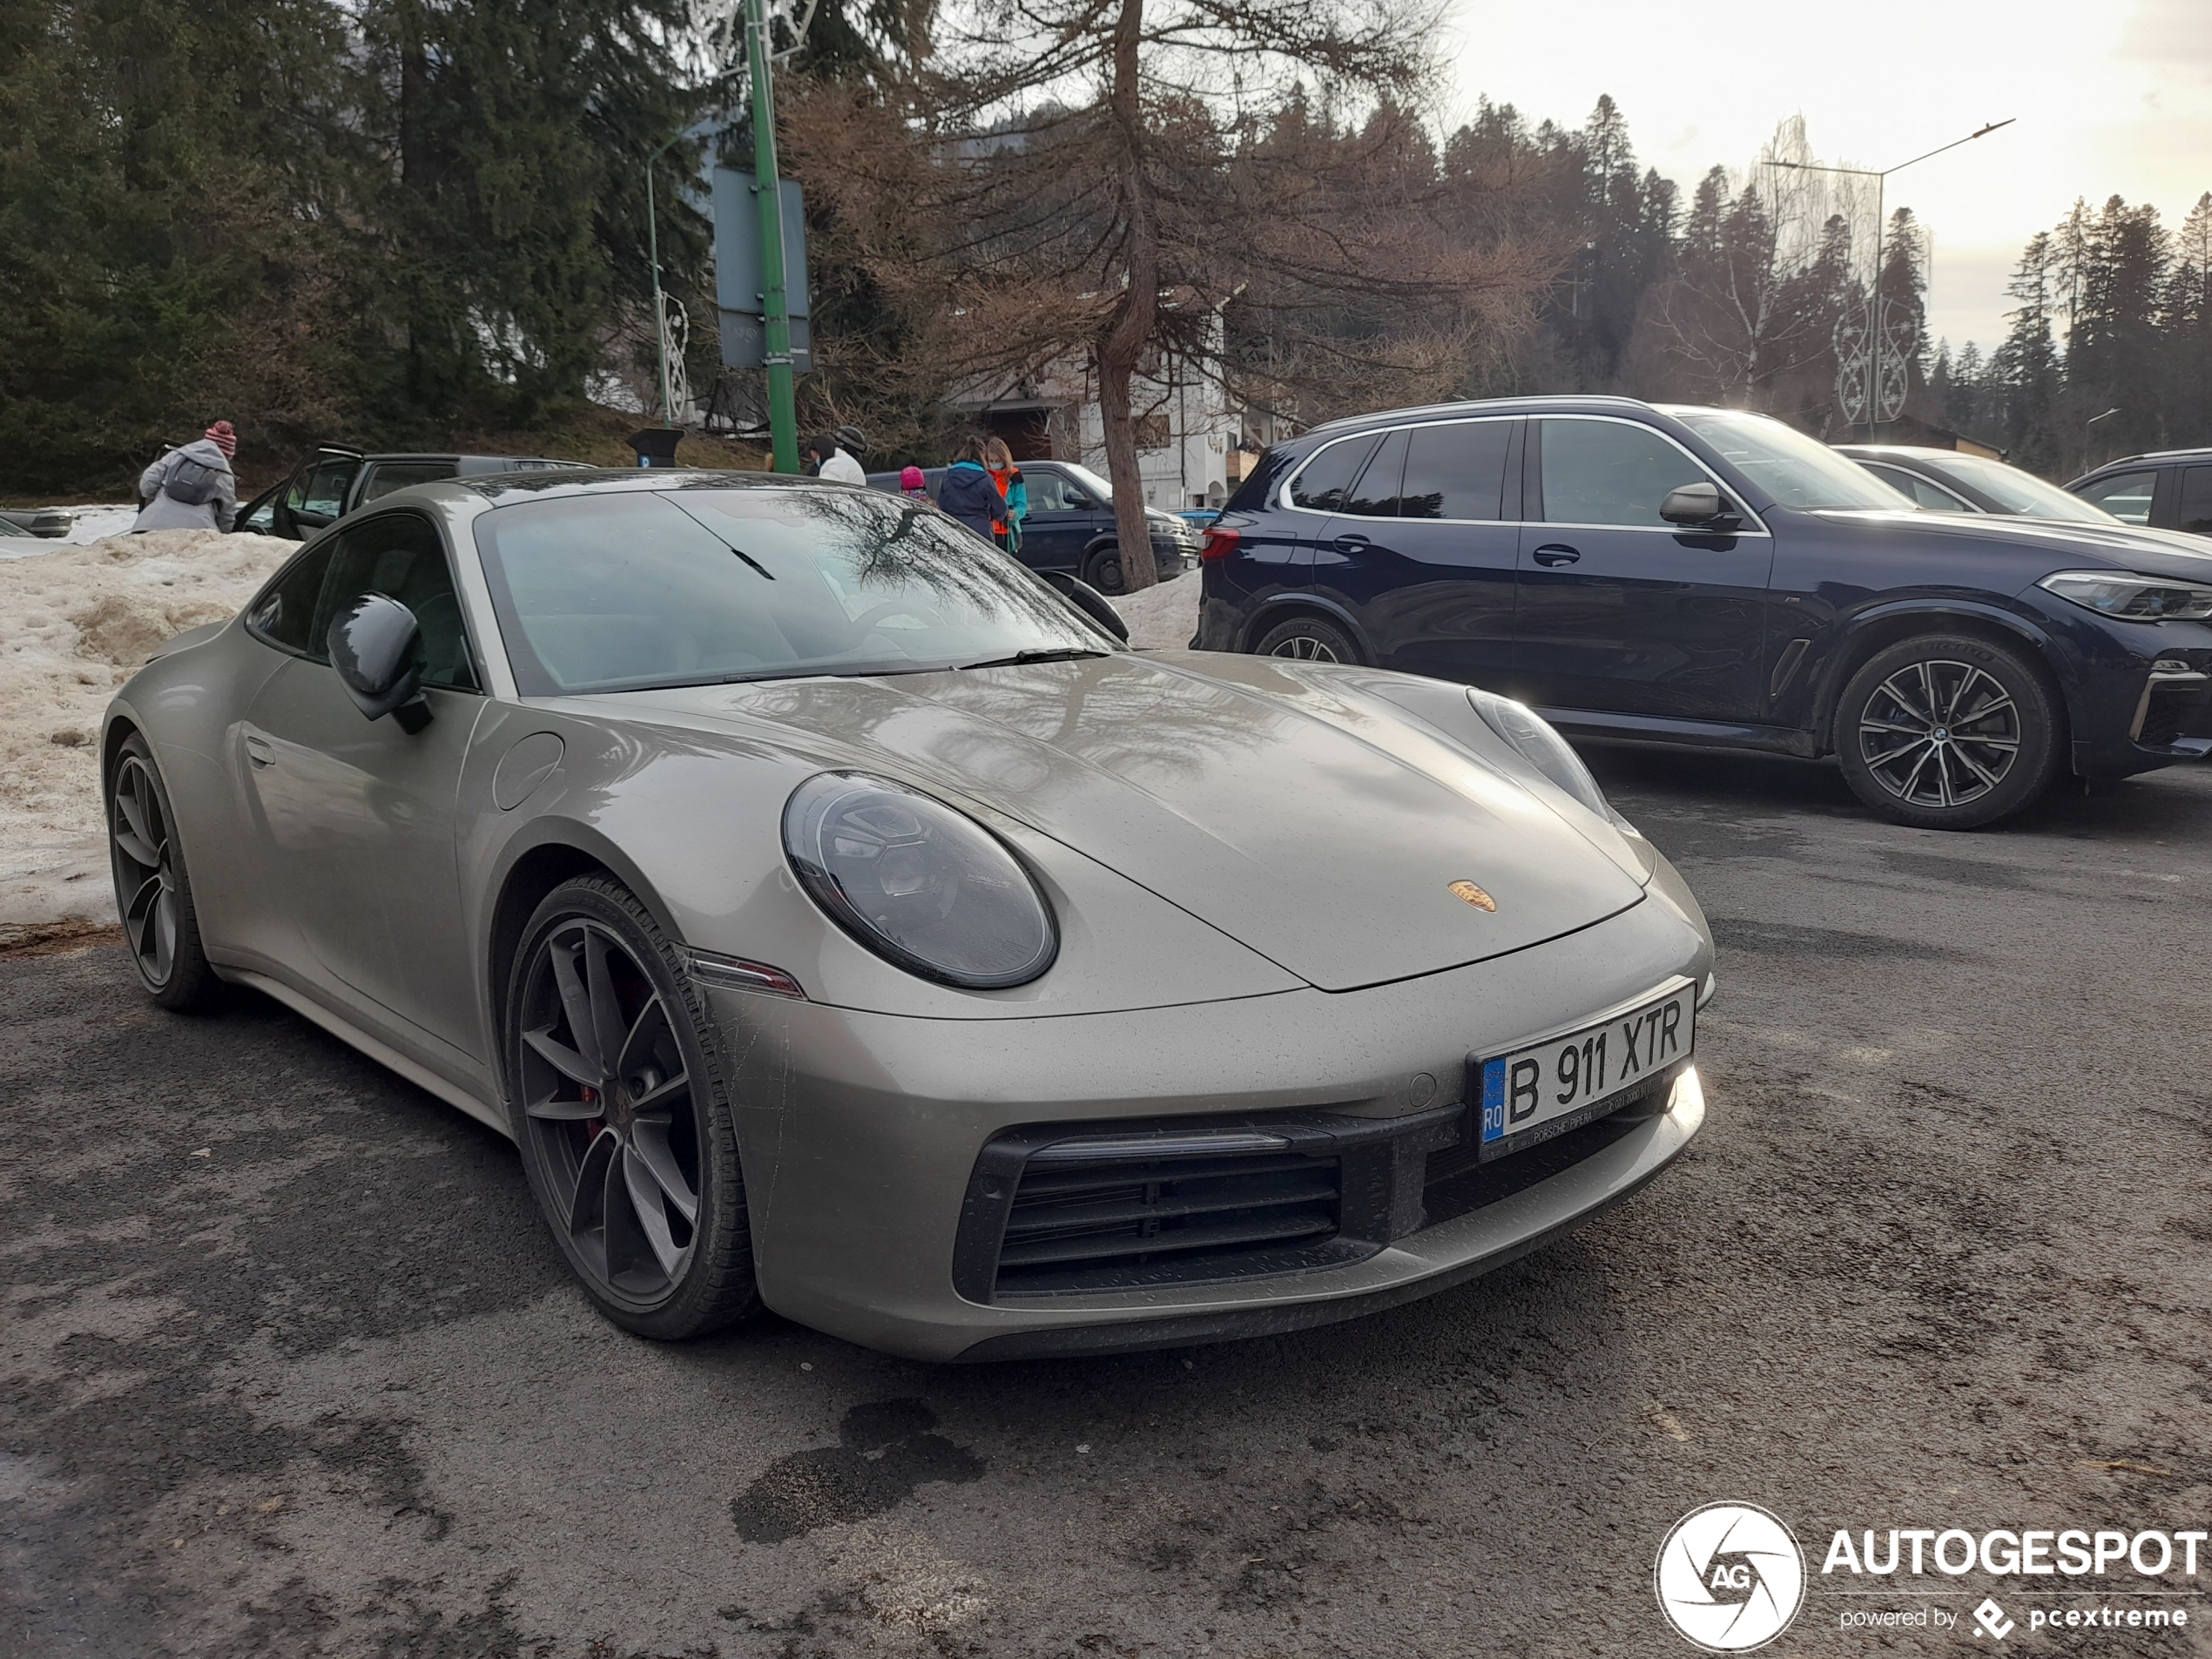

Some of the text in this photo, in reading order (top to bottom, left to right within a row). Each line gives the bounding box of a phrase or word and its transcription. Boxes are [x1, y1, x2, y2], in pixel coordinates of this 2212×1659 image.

[1509, 999, 1681, 1124] B 911 XTR
[1483, 1104, 1503, 1133] RO
[1534, 1122, 1566, 1143] PORSCHE
[1569, 1111, 1593, 1129] PIPERA
